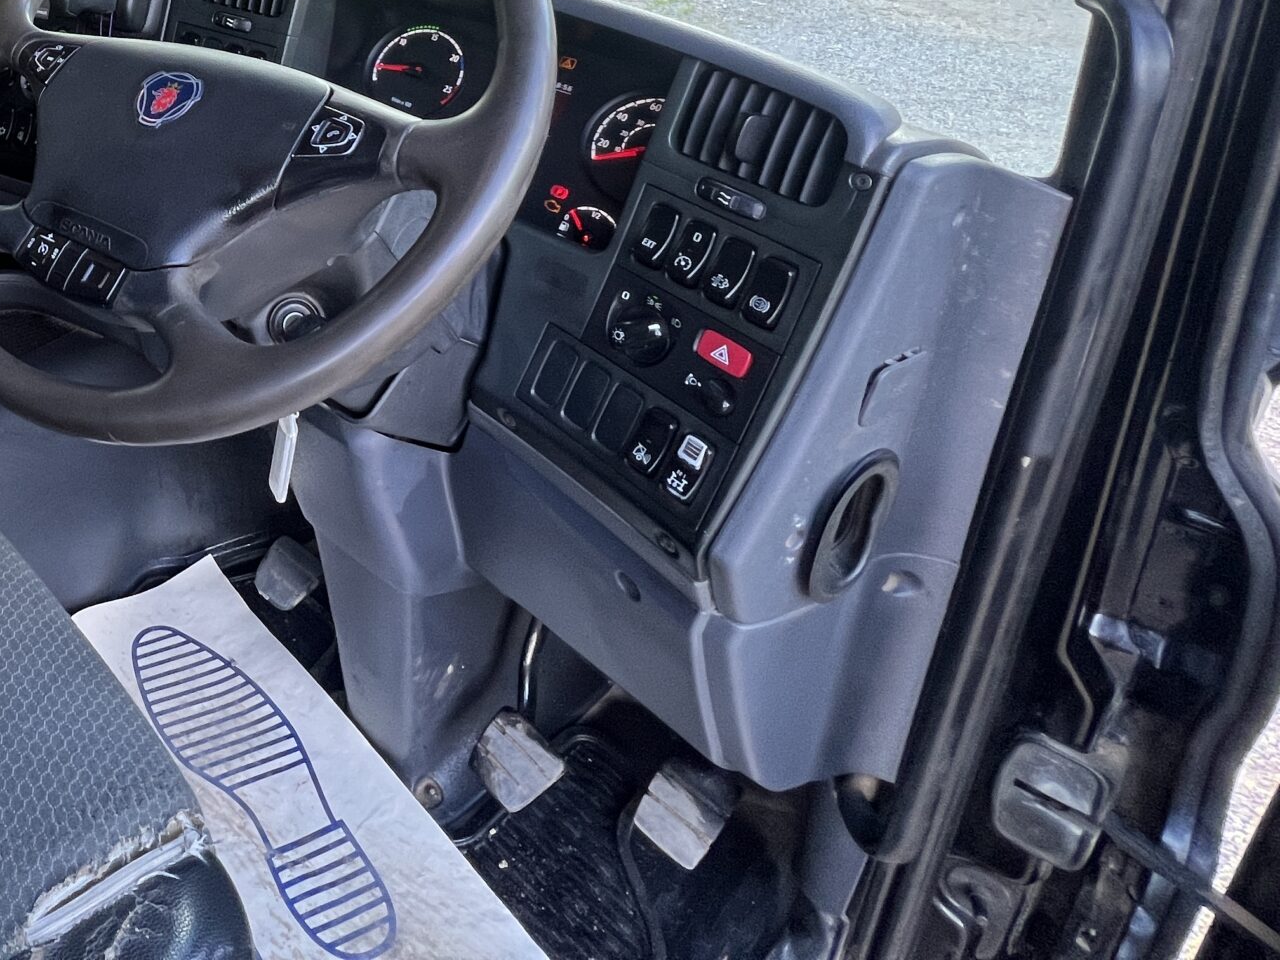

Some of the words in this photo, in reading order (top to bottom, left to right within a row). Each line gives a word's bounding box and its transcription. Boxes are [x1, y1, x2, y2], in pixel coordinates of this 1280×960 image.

[399, 38, 408, 46] 10
[431, 33, 439, 42] 15
[449, 54, 460, 63] 20
[442, 84, 453, 94] 25
[649, 102, 662, 112] 60
[616, 112, 628, 122] 40
[596, 138, 610, 148] 20
[60, 217, 112, 251] SCANIA
[692, 232, 702, 242] 0
[641, 238, 657, 249] EXT
[621, 290, 630, 300] 0
